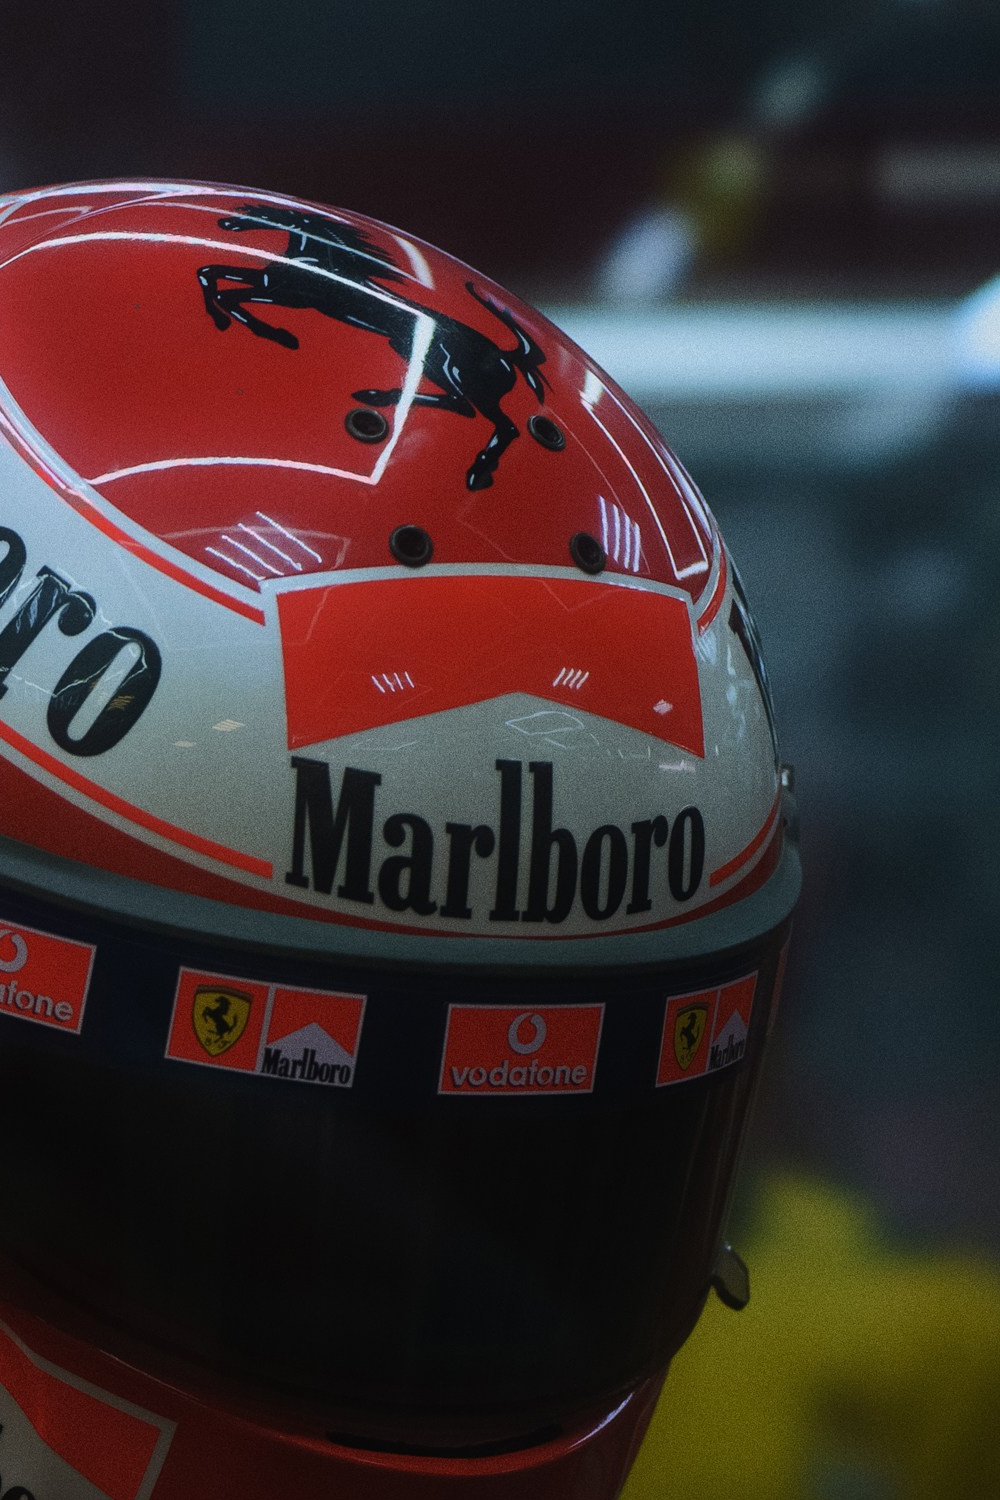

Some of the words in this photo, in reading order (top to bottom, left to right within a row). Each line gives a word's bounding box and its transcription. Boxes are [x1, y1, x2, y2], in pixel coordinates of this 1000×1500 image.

[285, 755, 705, 924] Marlboro
[261, 1047, 352, 1085] Marlboro
[451, 1058, 588, 1088] vodafone
